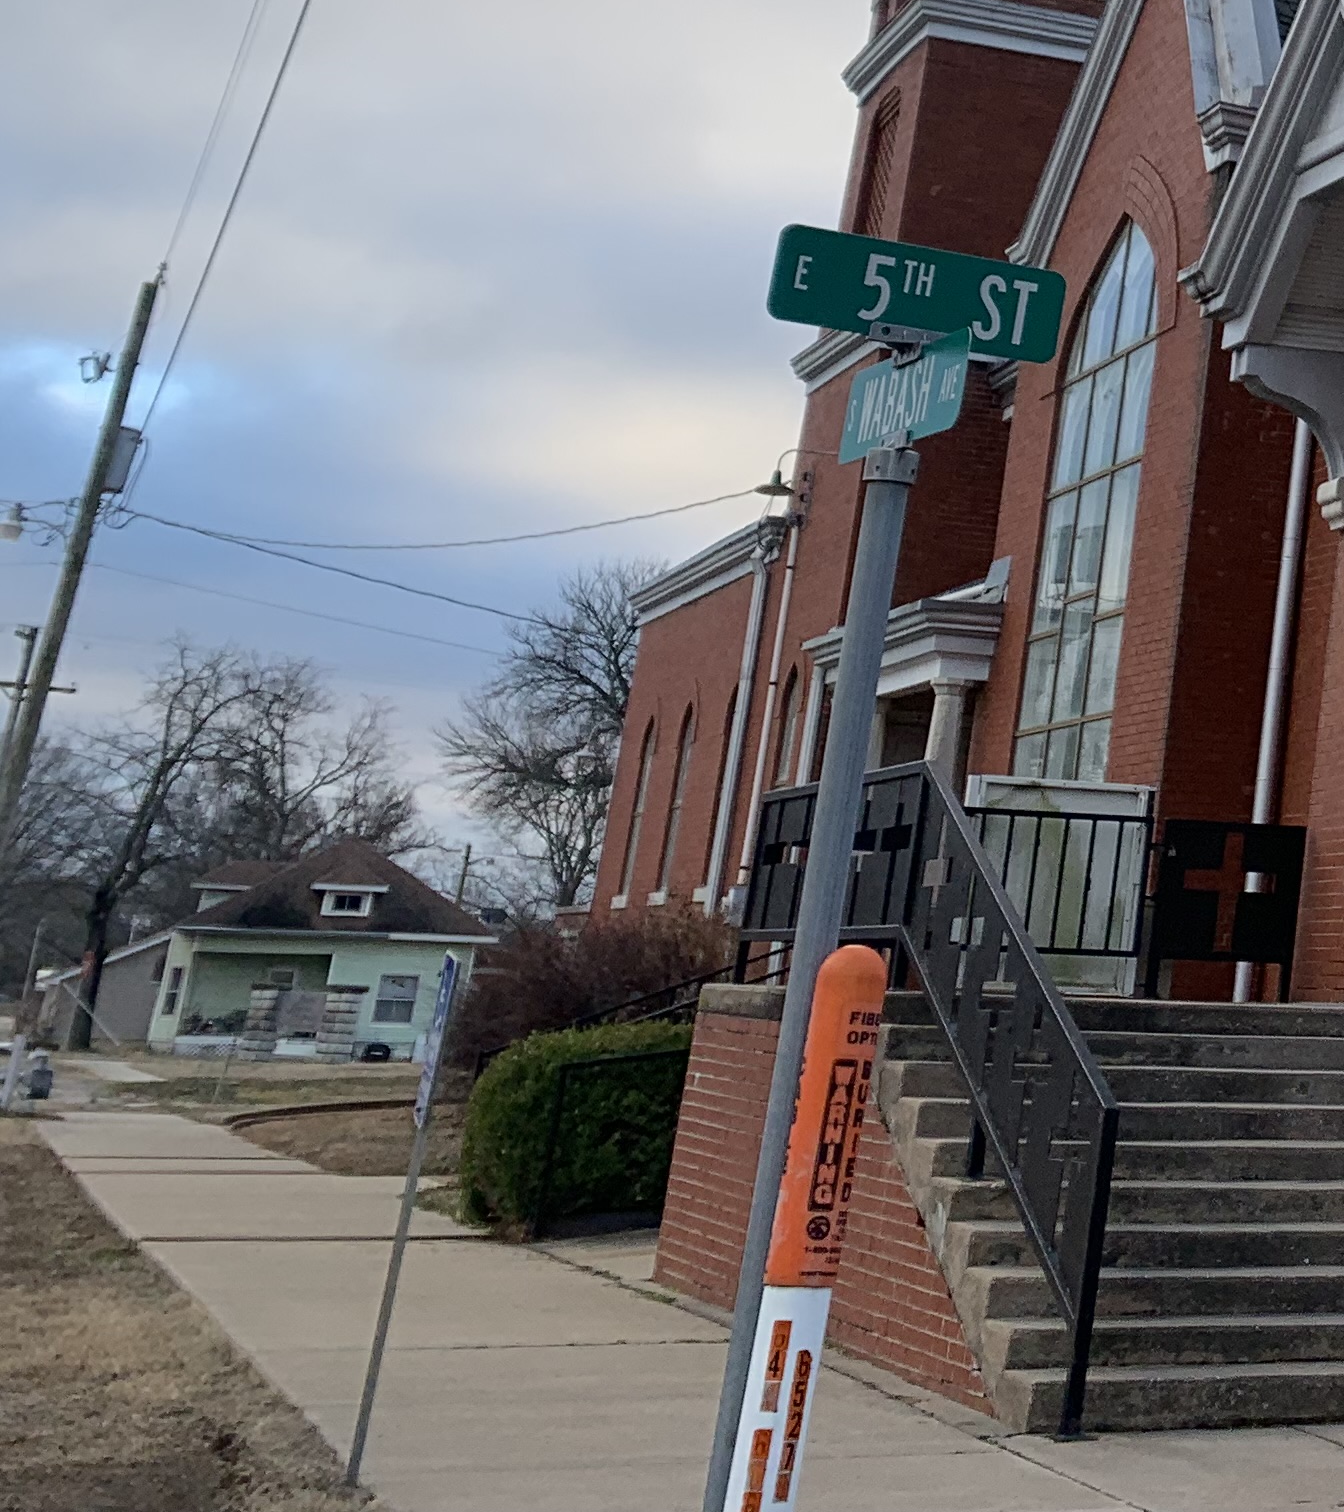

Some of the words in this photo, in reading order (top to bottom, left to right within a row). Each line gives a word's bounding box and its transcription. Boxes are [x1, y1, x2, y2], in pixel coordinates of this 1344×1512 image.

[793, 255, 813, 291] E
[856, 253, 936, 321] 5TH
[972, 274, 1039, 346] ST
[857, 354, 936, 445] WABASH
[937, 363, 963, 404] AVE
[813, 1065, 857, 1205] WARNING
[840, 1059, 873, 1203] BURIED
